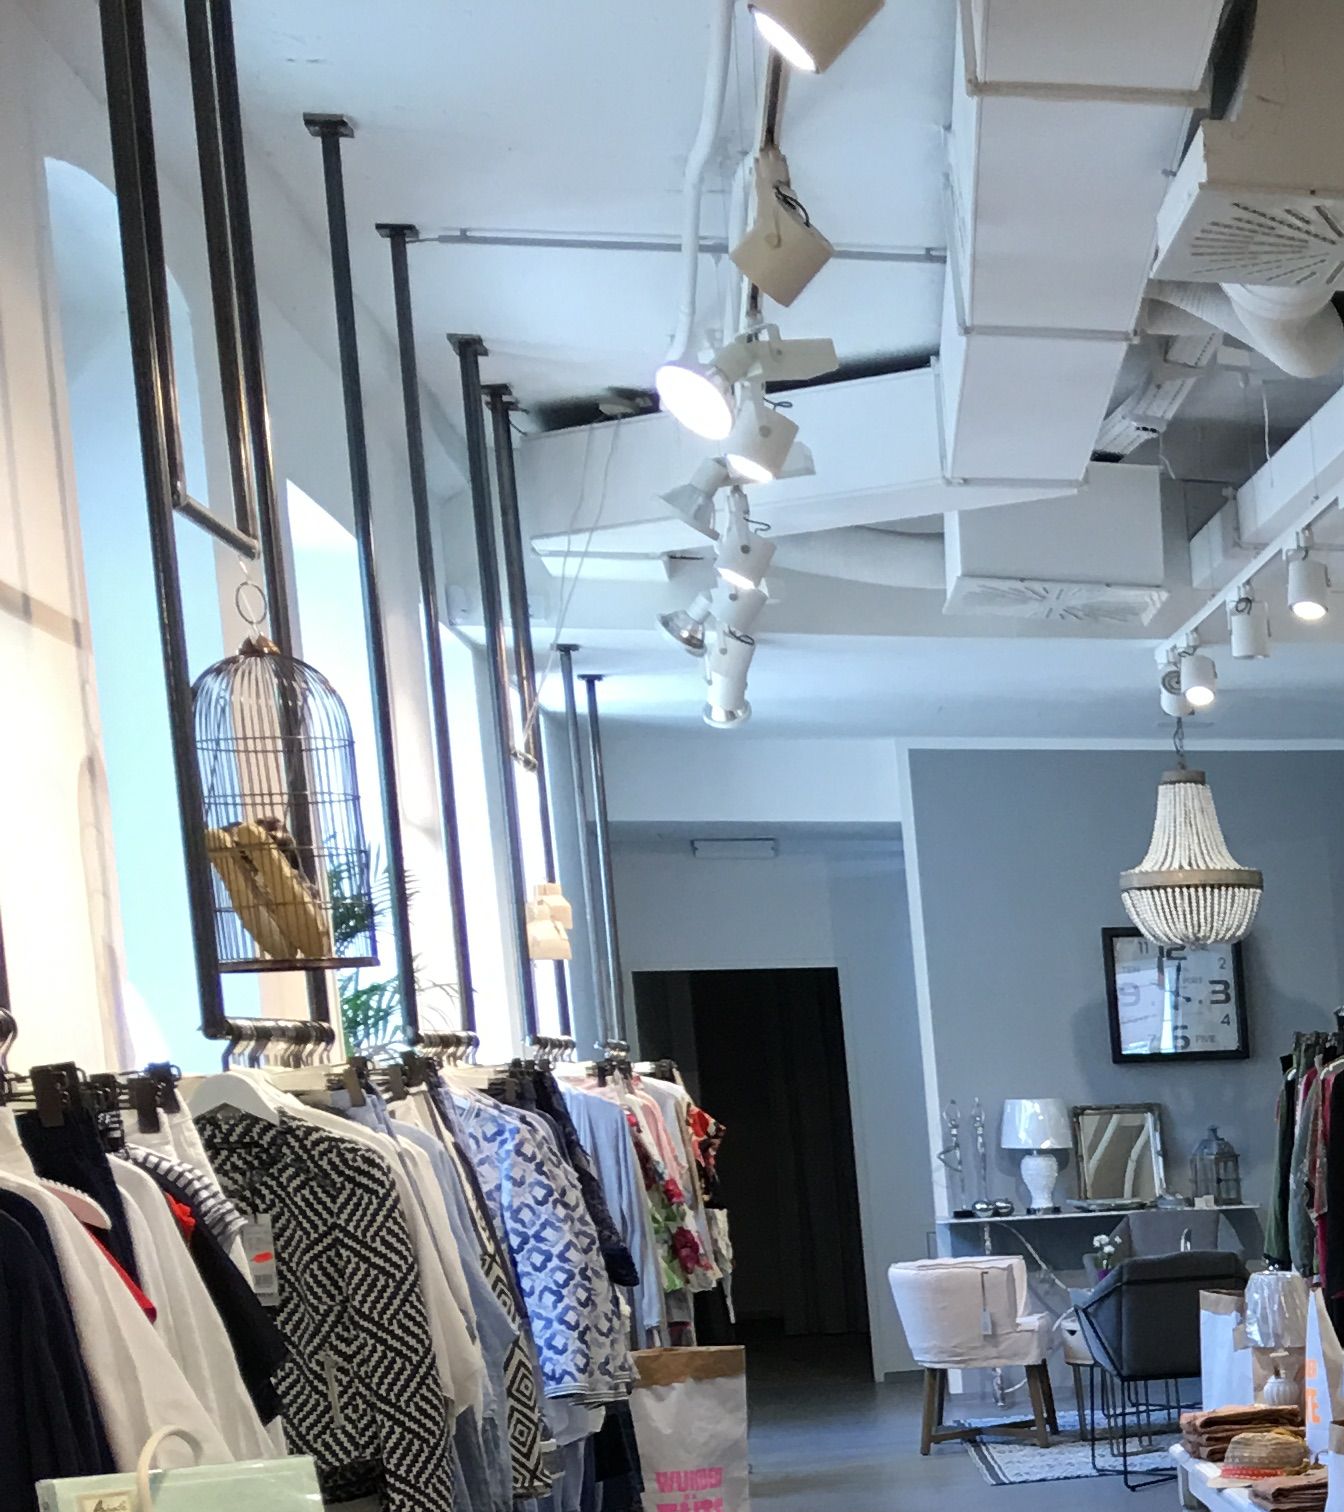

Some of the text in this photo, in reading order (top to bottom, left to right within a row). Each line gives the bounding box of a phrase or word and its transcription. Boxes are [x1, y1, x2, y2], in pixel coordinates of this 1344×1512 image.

[1217, 957, 1227, 970] 2
[1208, 979, 1231, 1005] 3
[1220, 1013, 1231, 1026] 4
